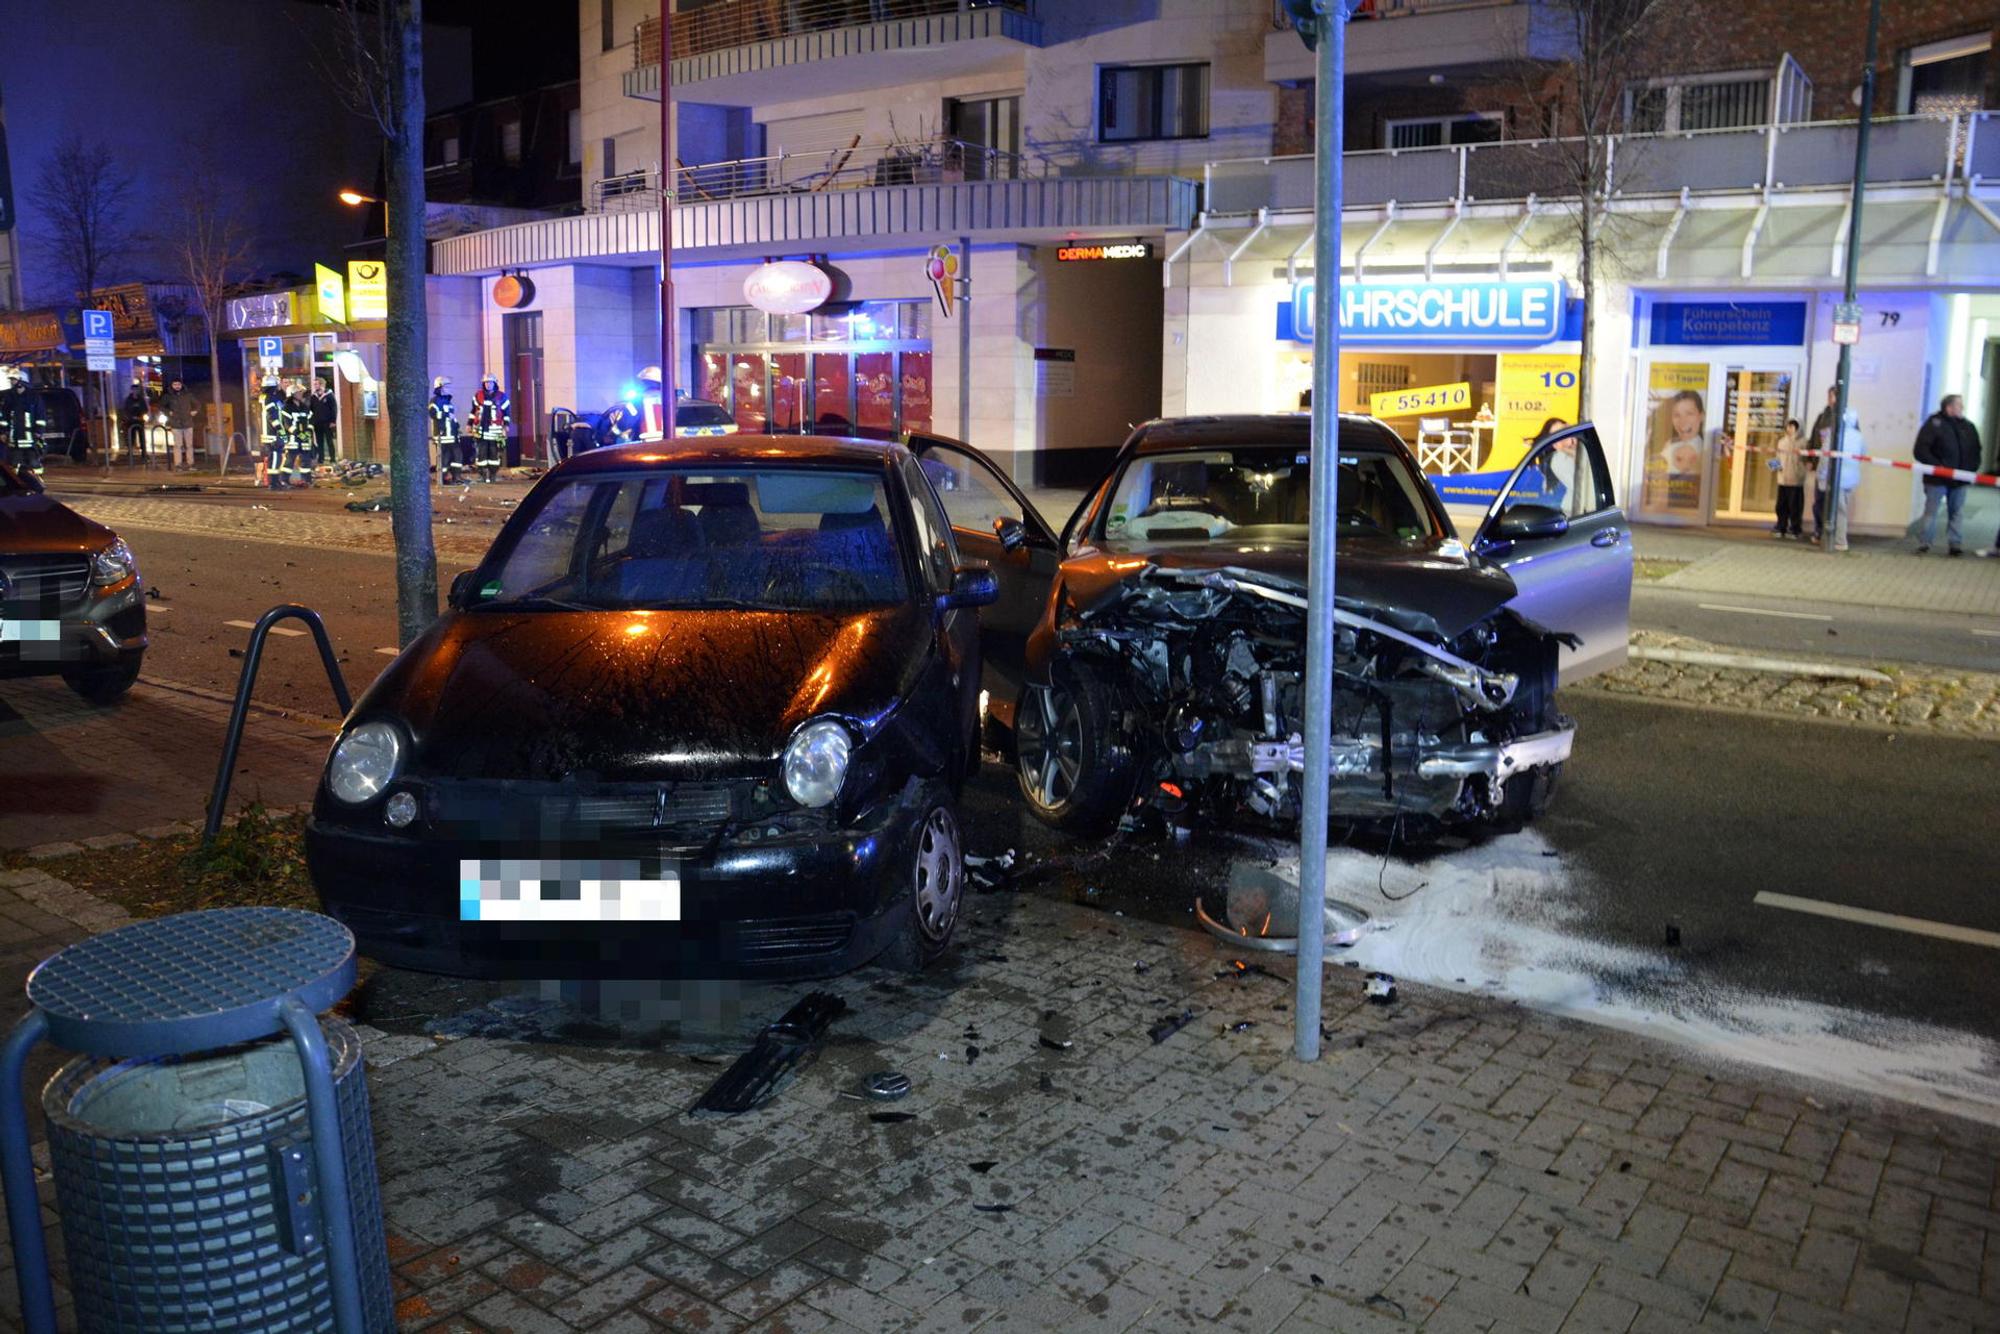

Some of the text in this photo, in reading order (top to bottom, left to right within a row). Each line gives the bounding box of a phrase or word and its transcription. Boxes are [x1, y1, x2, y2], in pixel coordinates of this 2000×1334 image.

[1058, 245, 1145, 260] DERMAMEDIC
[1306, 287, 1549, 328] HRSCHULE
[1683, 307, 1772, 320] Führerschein
[1682, 319, 1770, 334] Kompetenz
[1879, 311, 1900, 327] 79
[1540, 371, 1576, 388] 10
